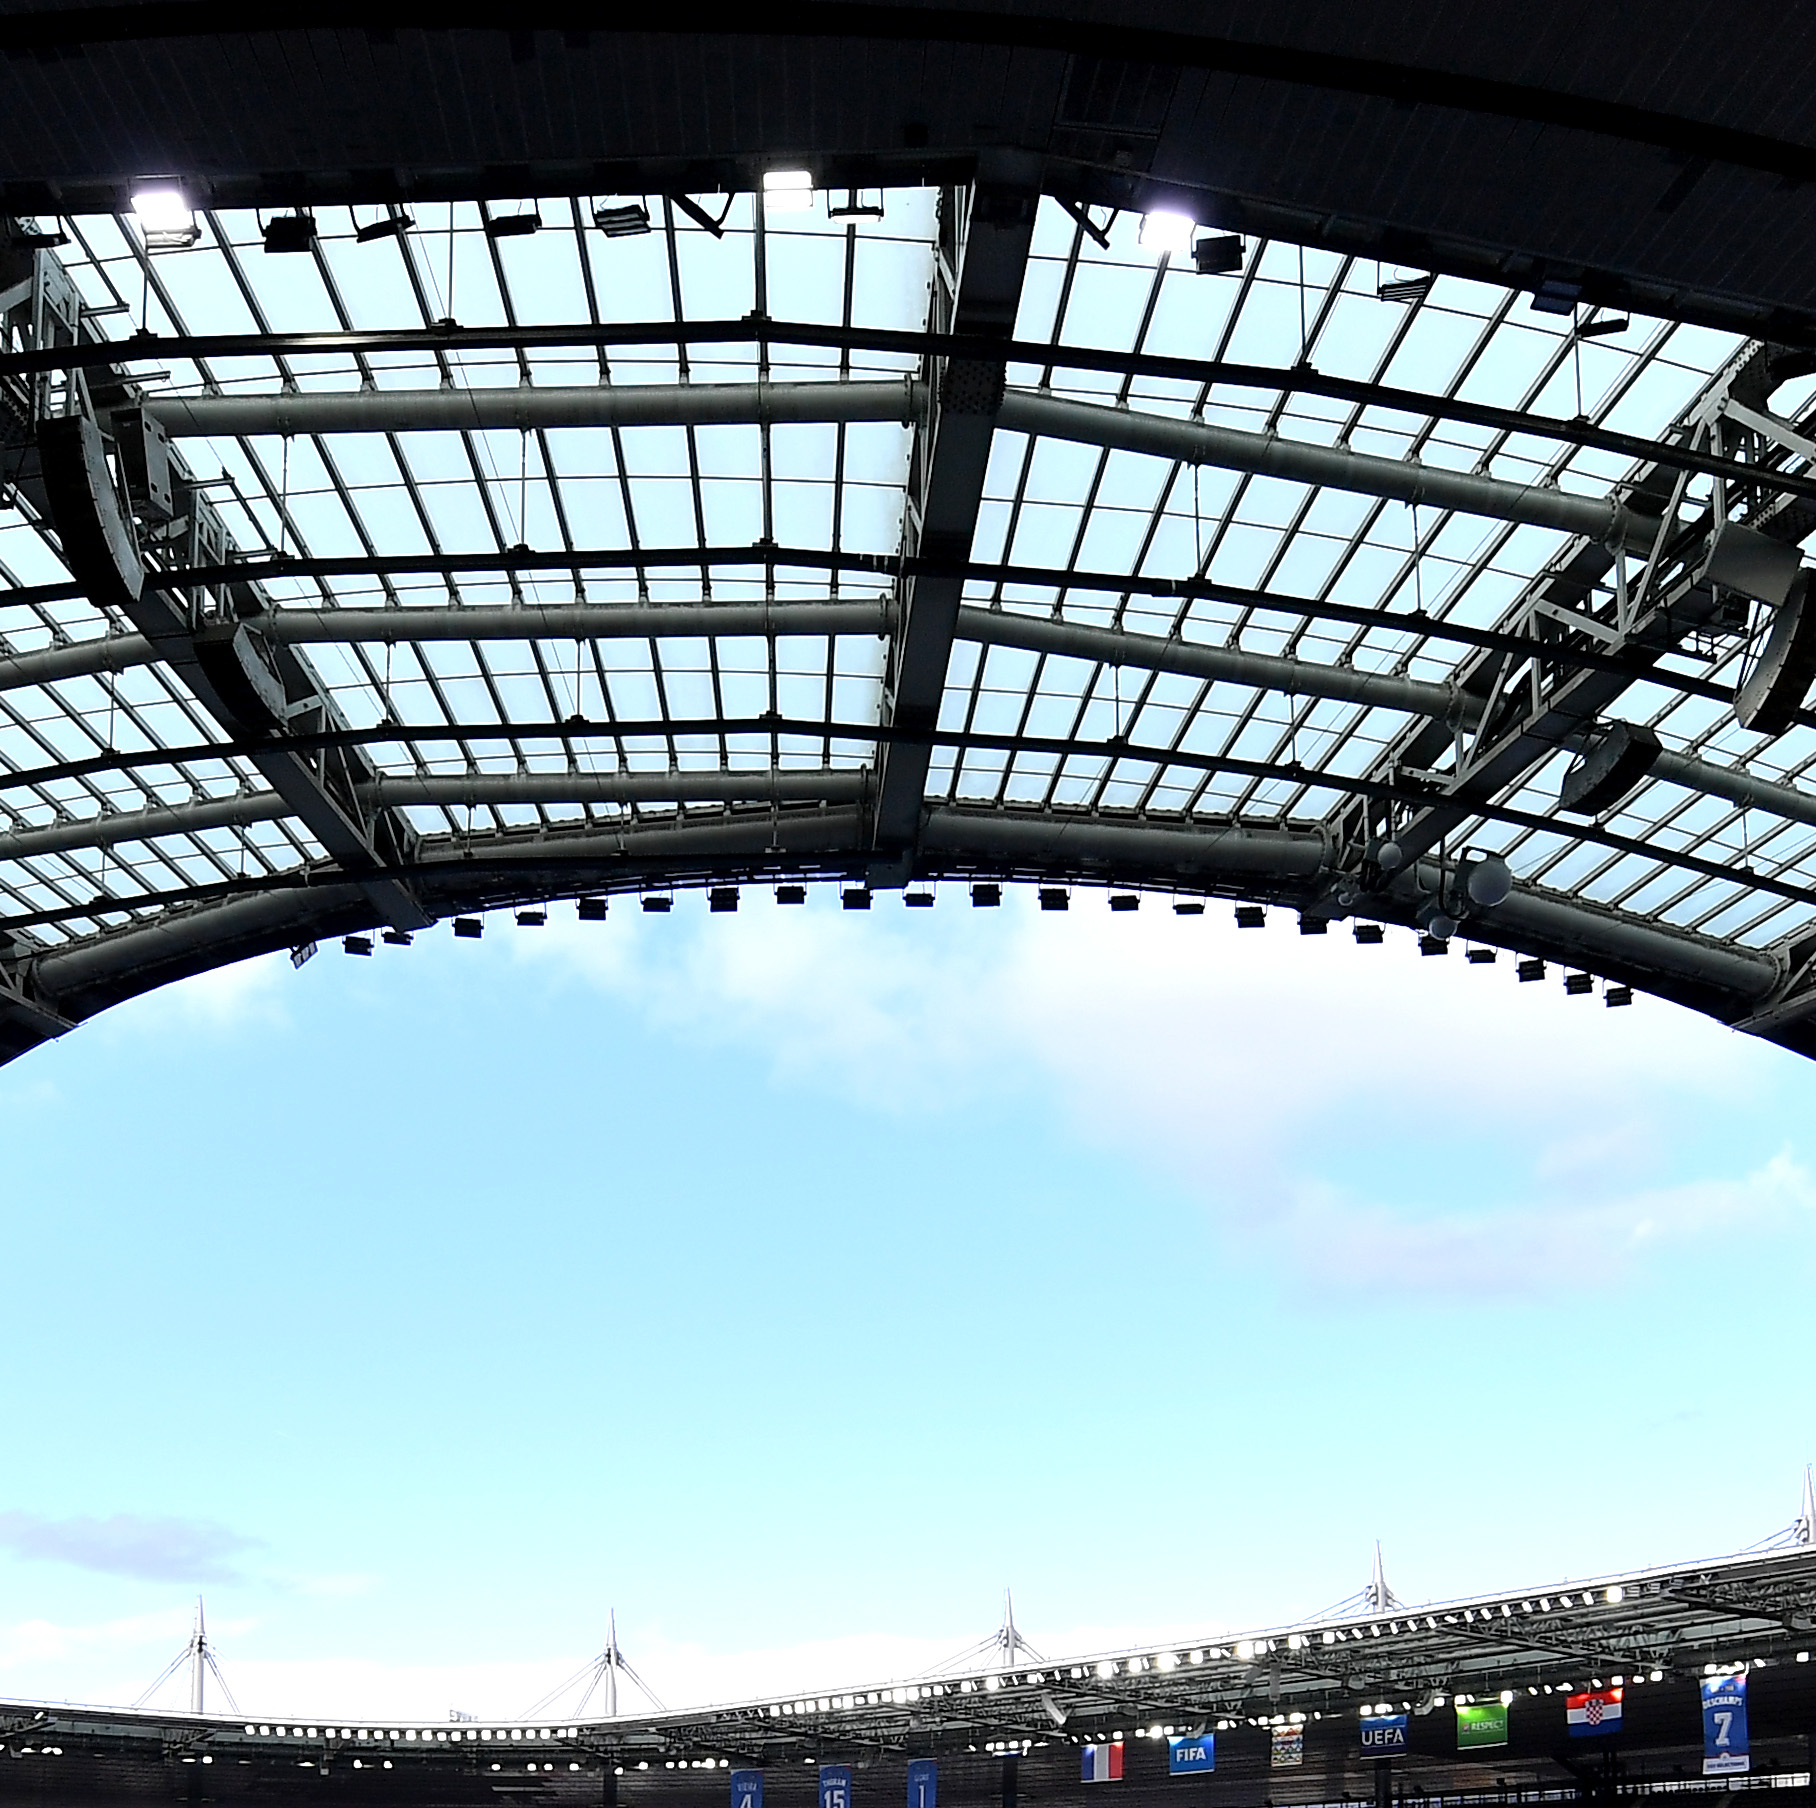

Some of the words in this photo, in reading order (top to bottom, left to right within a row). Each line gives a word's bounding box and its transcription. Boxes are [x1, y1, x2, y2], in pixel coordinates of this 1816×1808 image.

[1361, 1729, 1404, 1746] UEFA
[1714, 1712, 1732, 1746] 7
[1176, 1747, 1206, 1763] FIFA
